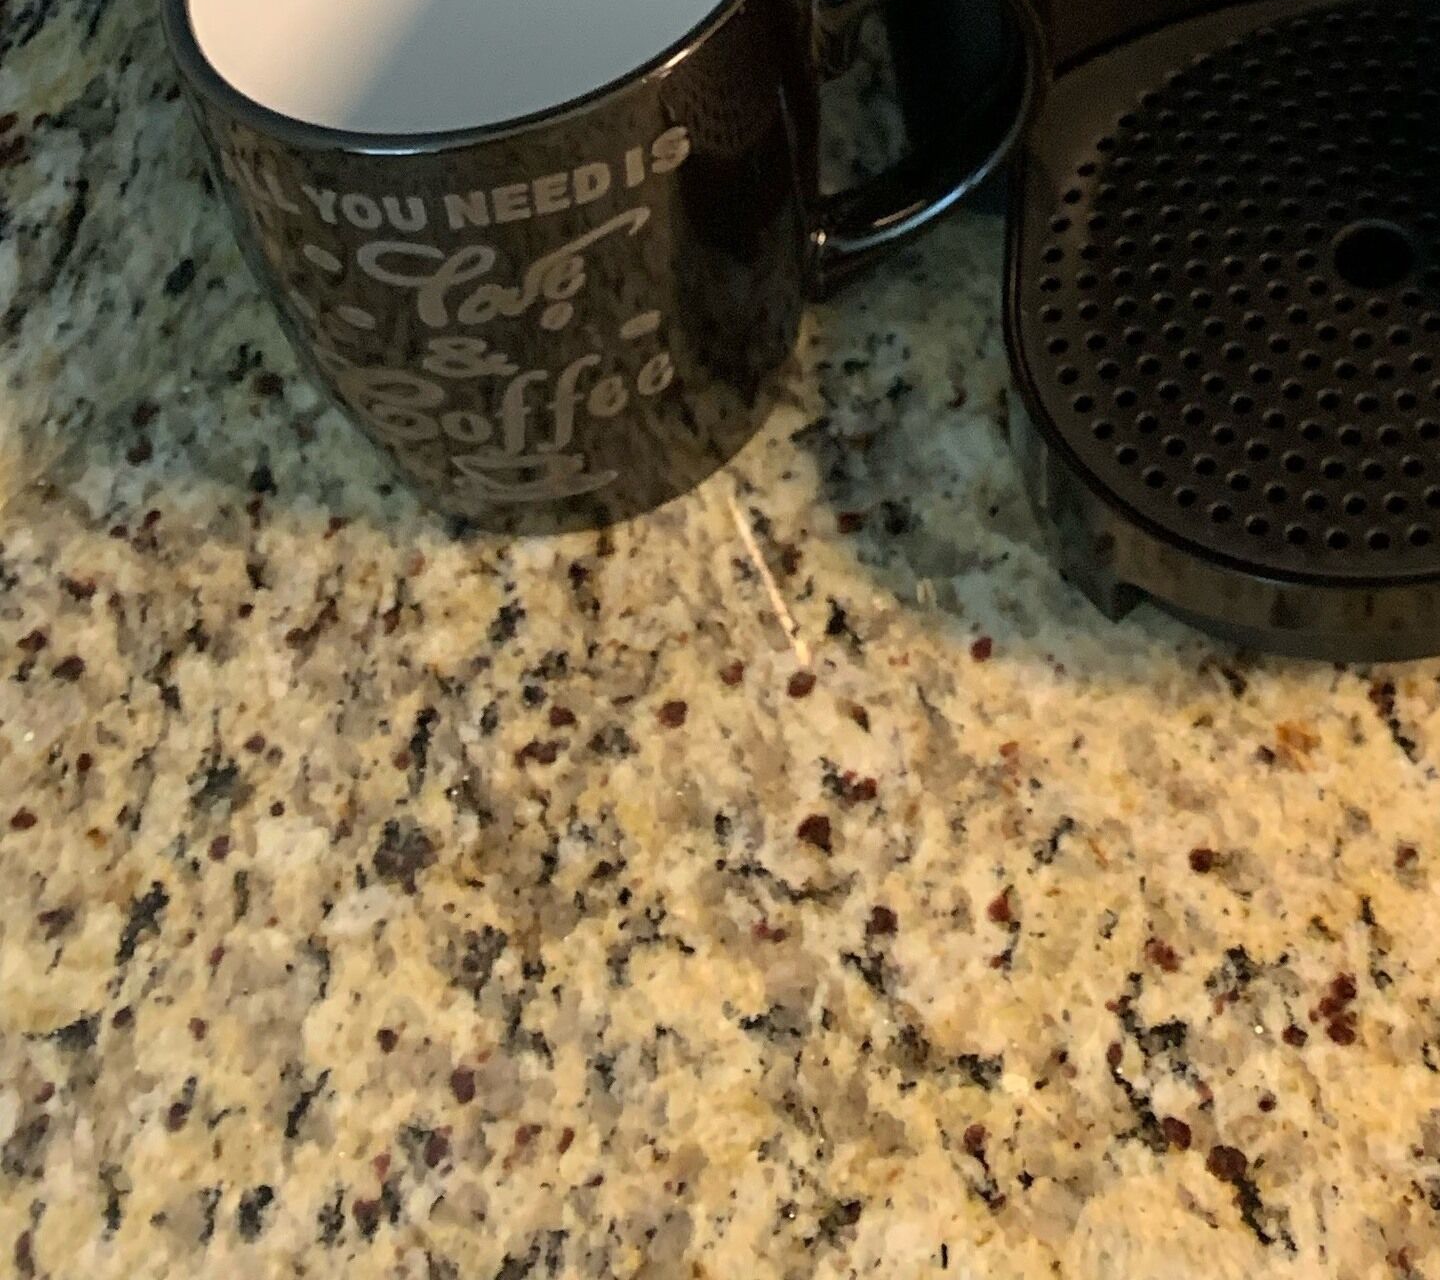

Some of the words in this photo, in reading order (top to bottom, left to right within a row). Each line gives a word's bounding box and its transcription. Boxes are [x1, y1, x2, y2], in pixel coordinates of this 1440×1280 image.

[299, 183, 428, 232] YOU
[444, 161, 612, 229] NEED
[624, 125, 692, 188] IS
[313, 343, 676, 458] Coffee
[421, 336, 520, 378] &
